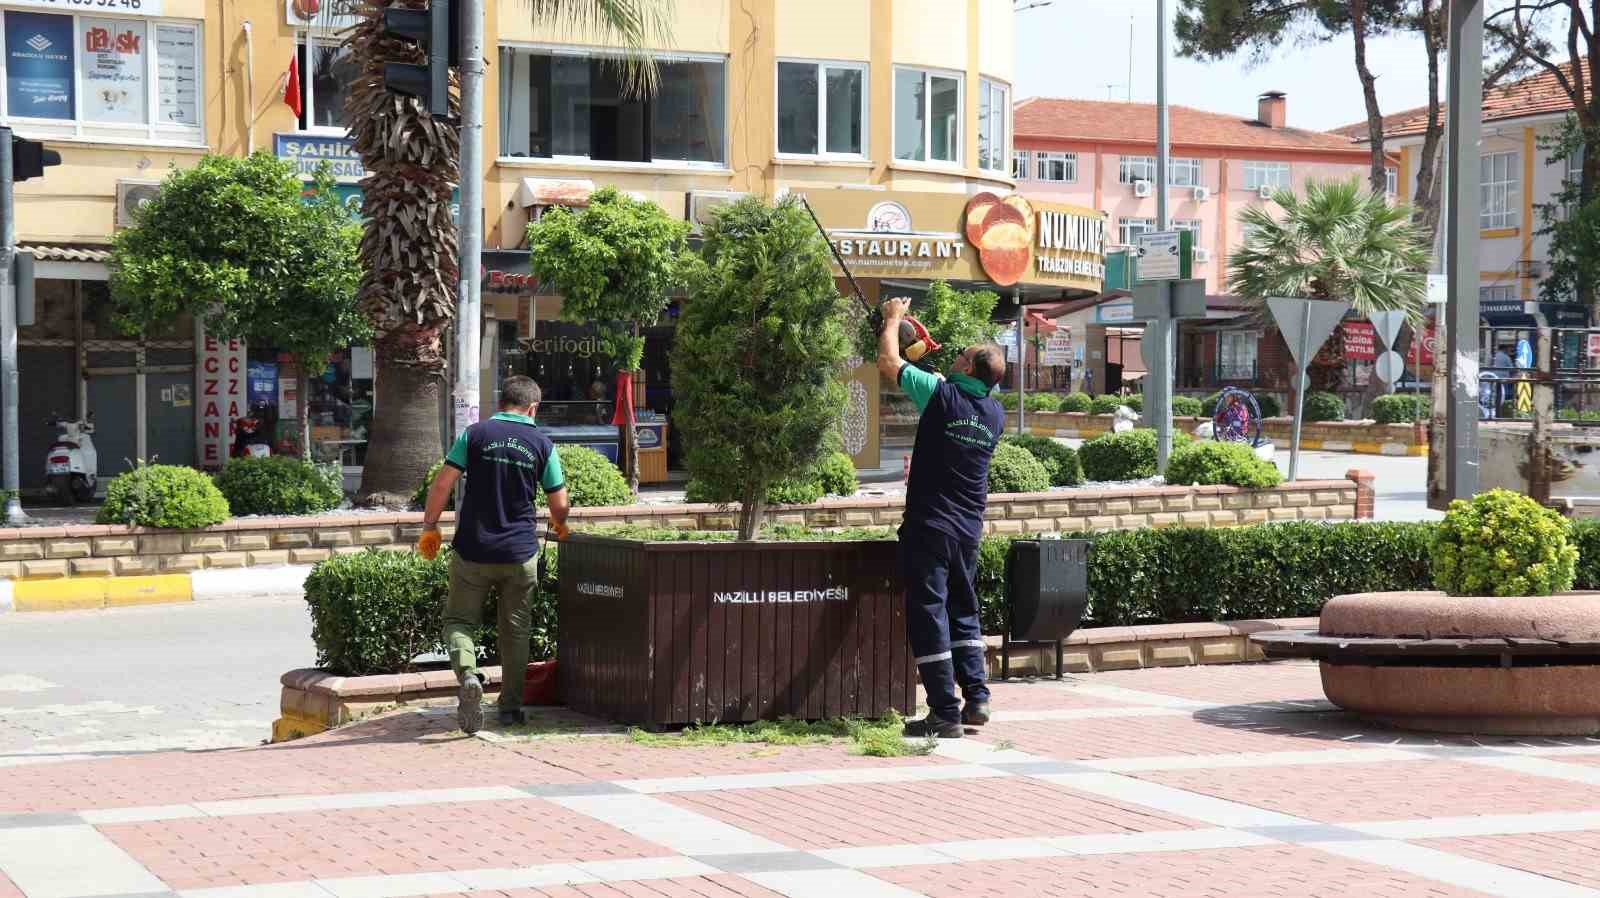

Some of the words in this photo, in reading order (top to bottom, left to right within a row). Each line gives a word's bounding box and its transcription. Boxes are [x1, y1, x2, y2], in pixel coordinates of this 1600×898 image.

[204, 335, 219, 460] ECZANE
[713, 590, 765, 604] NAZİLLİ
[768, 586, 849, 604] BELEDİYESİ
